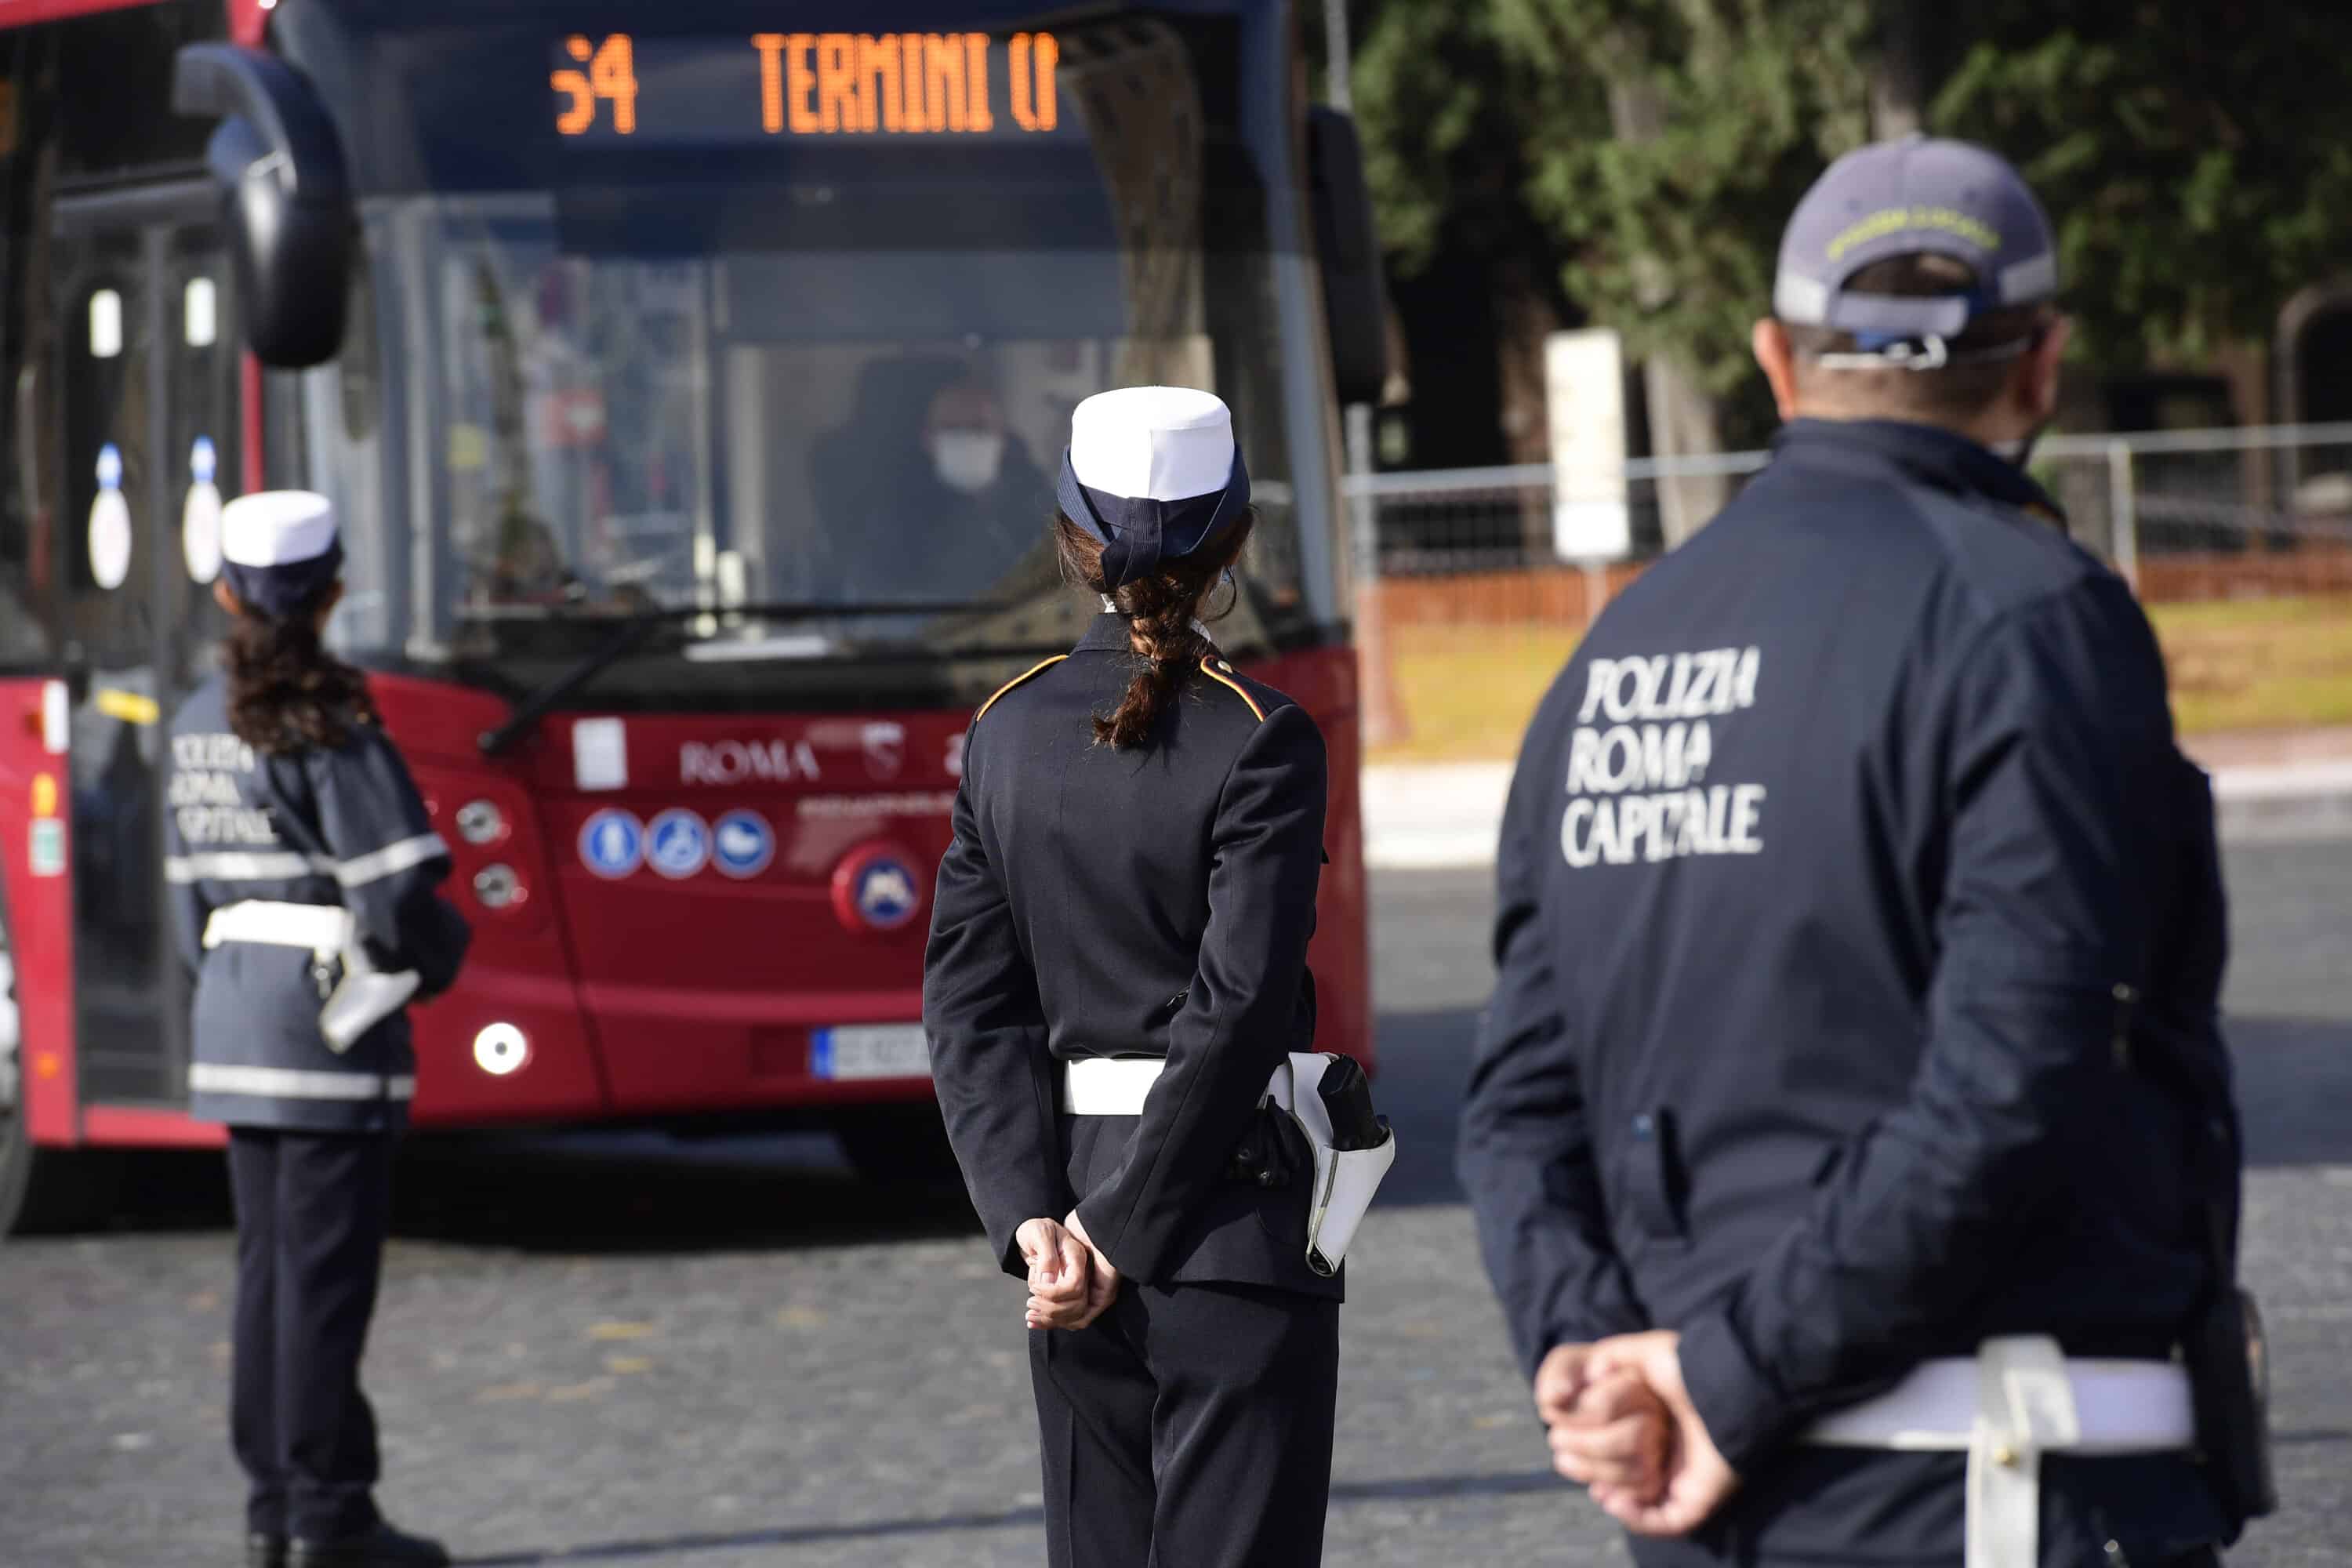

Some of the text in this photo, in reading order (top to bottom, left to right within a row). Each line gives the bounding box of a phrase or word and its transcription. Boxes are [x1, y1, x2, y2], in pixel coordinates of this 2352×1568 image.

[751, 33, 994, 134] TERMINI
[1577, 644, 1761, 723] POLIZIA
[679, 740, 820, 784] ROMA
[1566, 720, 1711, 794] ROMA
[1561, 783, 1767, 868] CAPITALE
